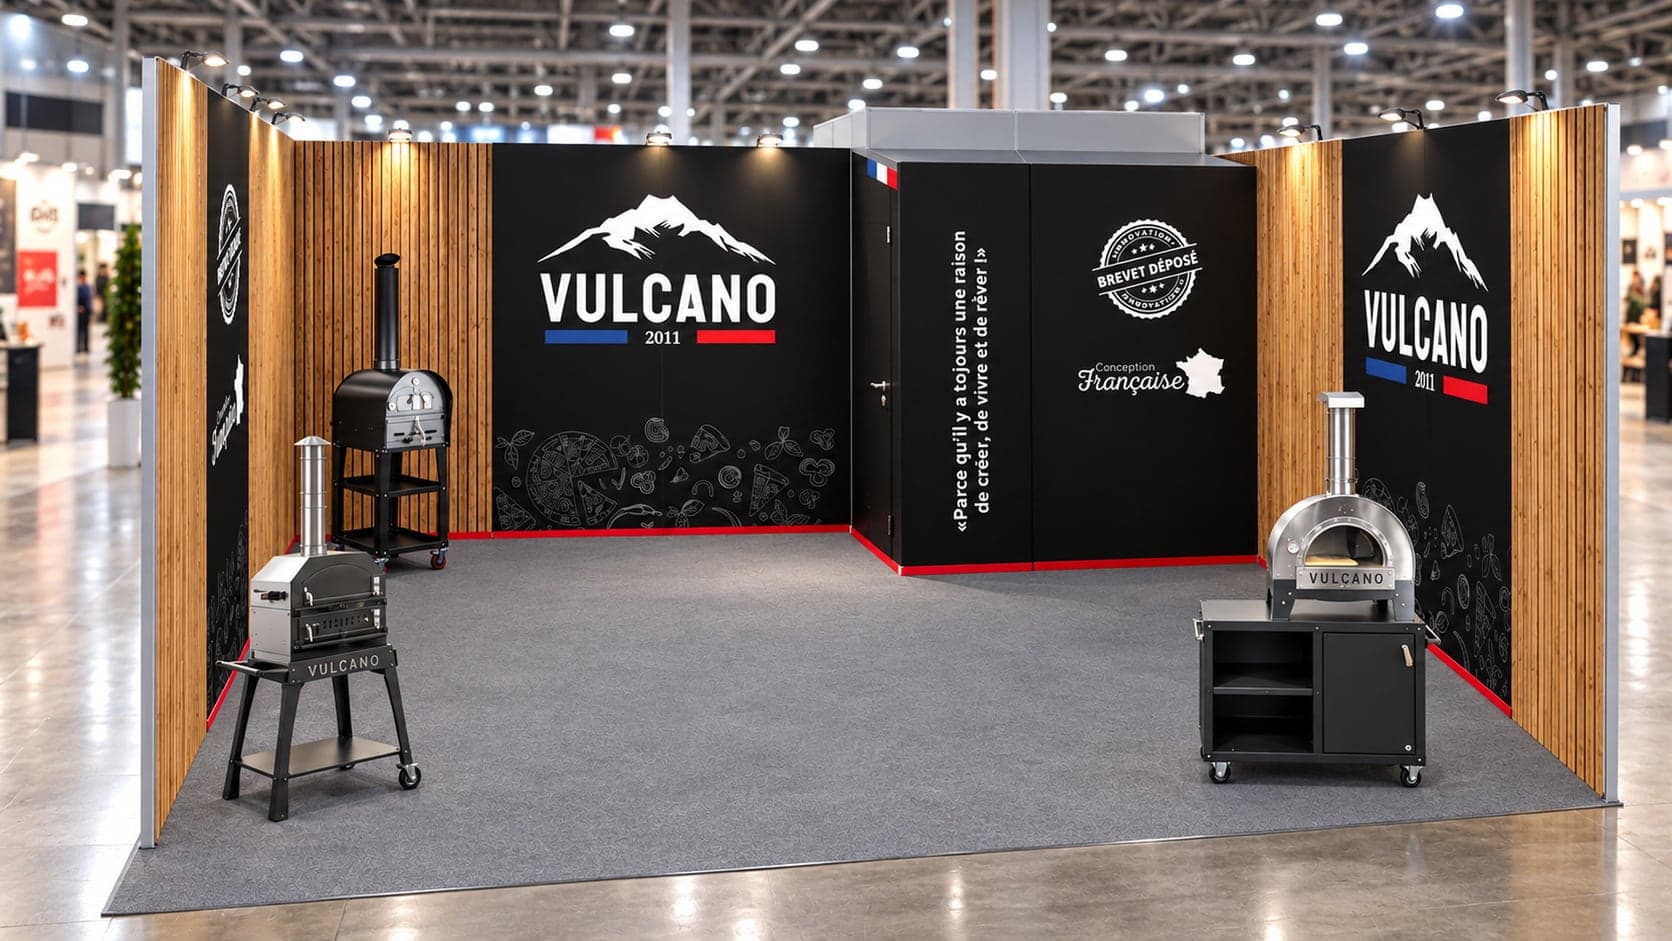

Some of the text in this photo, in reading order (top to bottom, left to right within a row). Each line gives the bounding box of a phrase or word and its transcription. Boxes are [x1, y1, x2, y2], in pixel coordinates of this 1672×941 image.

[951, 231, 966, 284] raison
[1097, 249, 1199, 288] BREVET DÉPOSÉ
[539, 272, 776, 324] VULCANO
[971, 267, 988, 312] rêver
[955, 288, 967, 322] une
[645, 330, 681, 345] 2011
[973, 316, 988, 337] de
[1364, 289, 1488, 374] VULCANO
[952, 327, 970, 392] tojours
[974, 341, 988, 358] et
[1095, 362, 1156, 374] Conception
[1414, 369, 1435, 392] 2011
[973, 363, 989, 405] vivre
[1078, 368, 1185, 396] Française
[956, 396, 968, 407] a
[956, 411, 972, 423] y
[973, 410, 989, 431] de
[975, 436, 992, 487] créer,
[953, 470, 968, 532] «Parce
[974, 491, 990, 514] de
[1309, 572, 1384, 584] VULCANO
[308, 654, 379, 677] VULCANO
